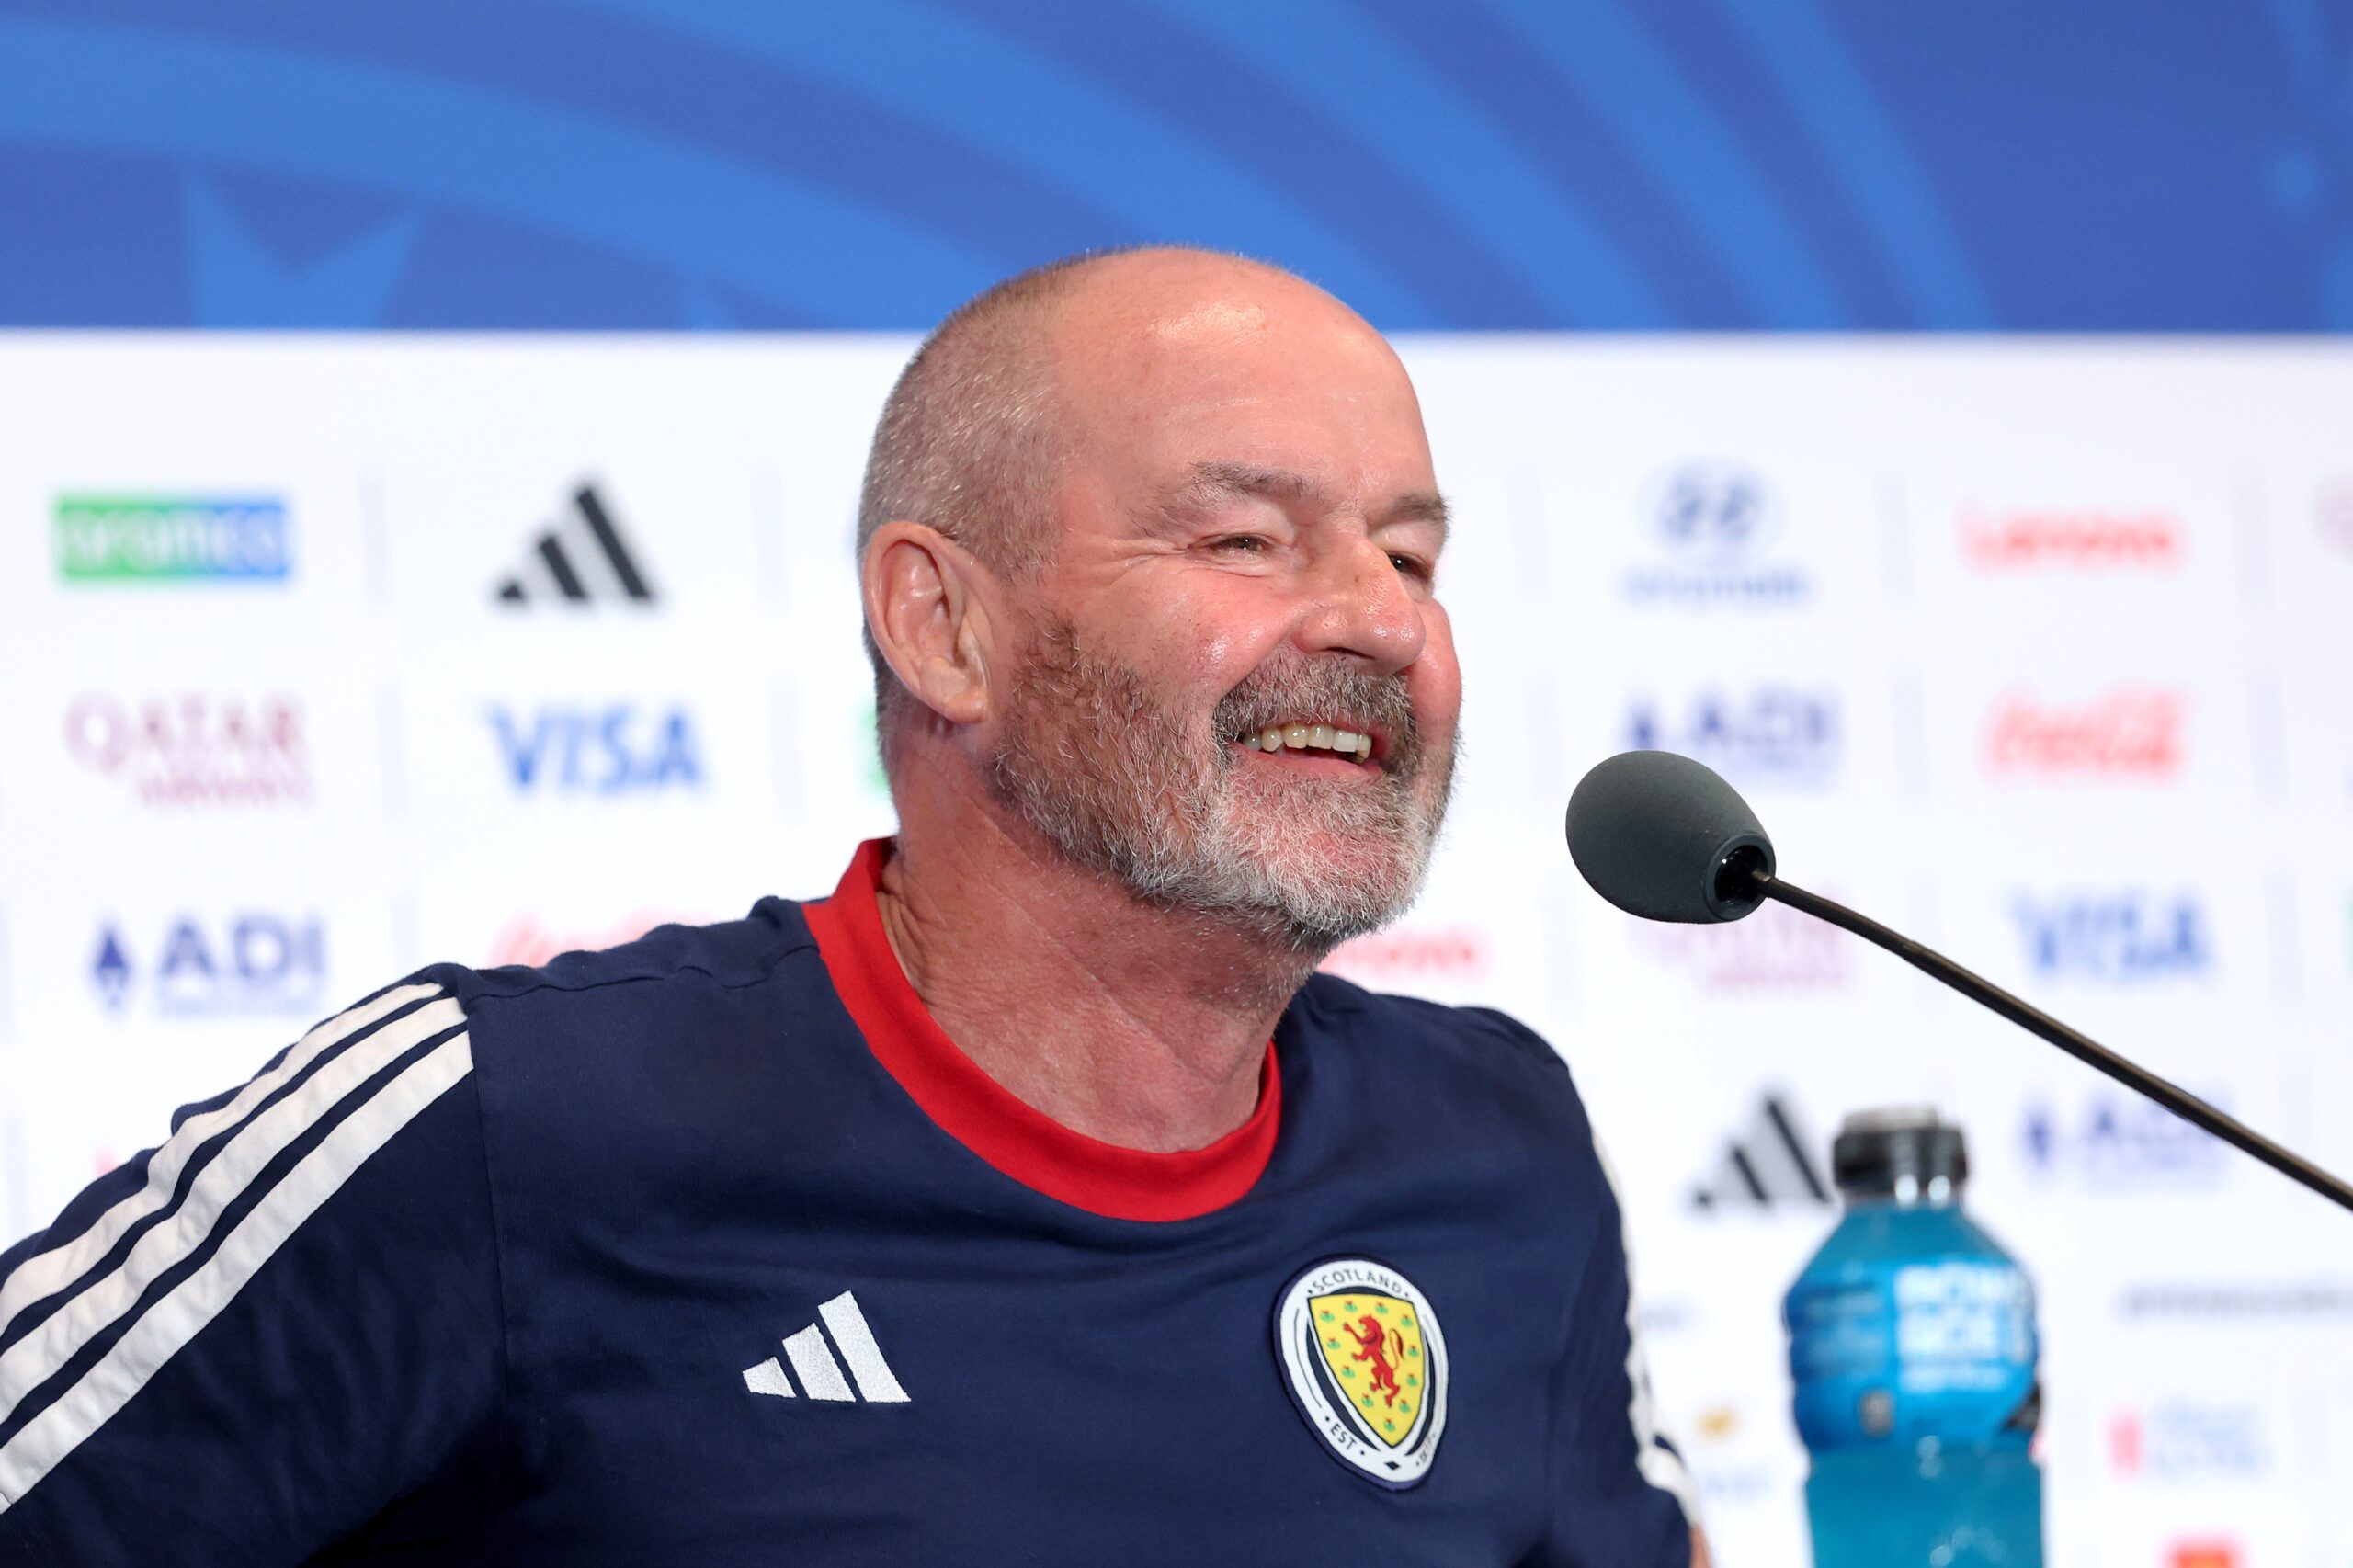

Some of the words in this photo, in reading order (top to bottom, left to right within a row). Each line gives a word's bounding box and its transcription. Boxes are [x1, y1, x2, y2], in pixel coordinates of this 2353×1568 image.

[483, 702, 705, 796] VISA
[156, 914, 329, 980] ADI
[2007, 890, 2215, 985] VISA
[1312, 1269, 1403, 1293] SCOTLAND
[1329, 1423, 1358, 1450] EST
